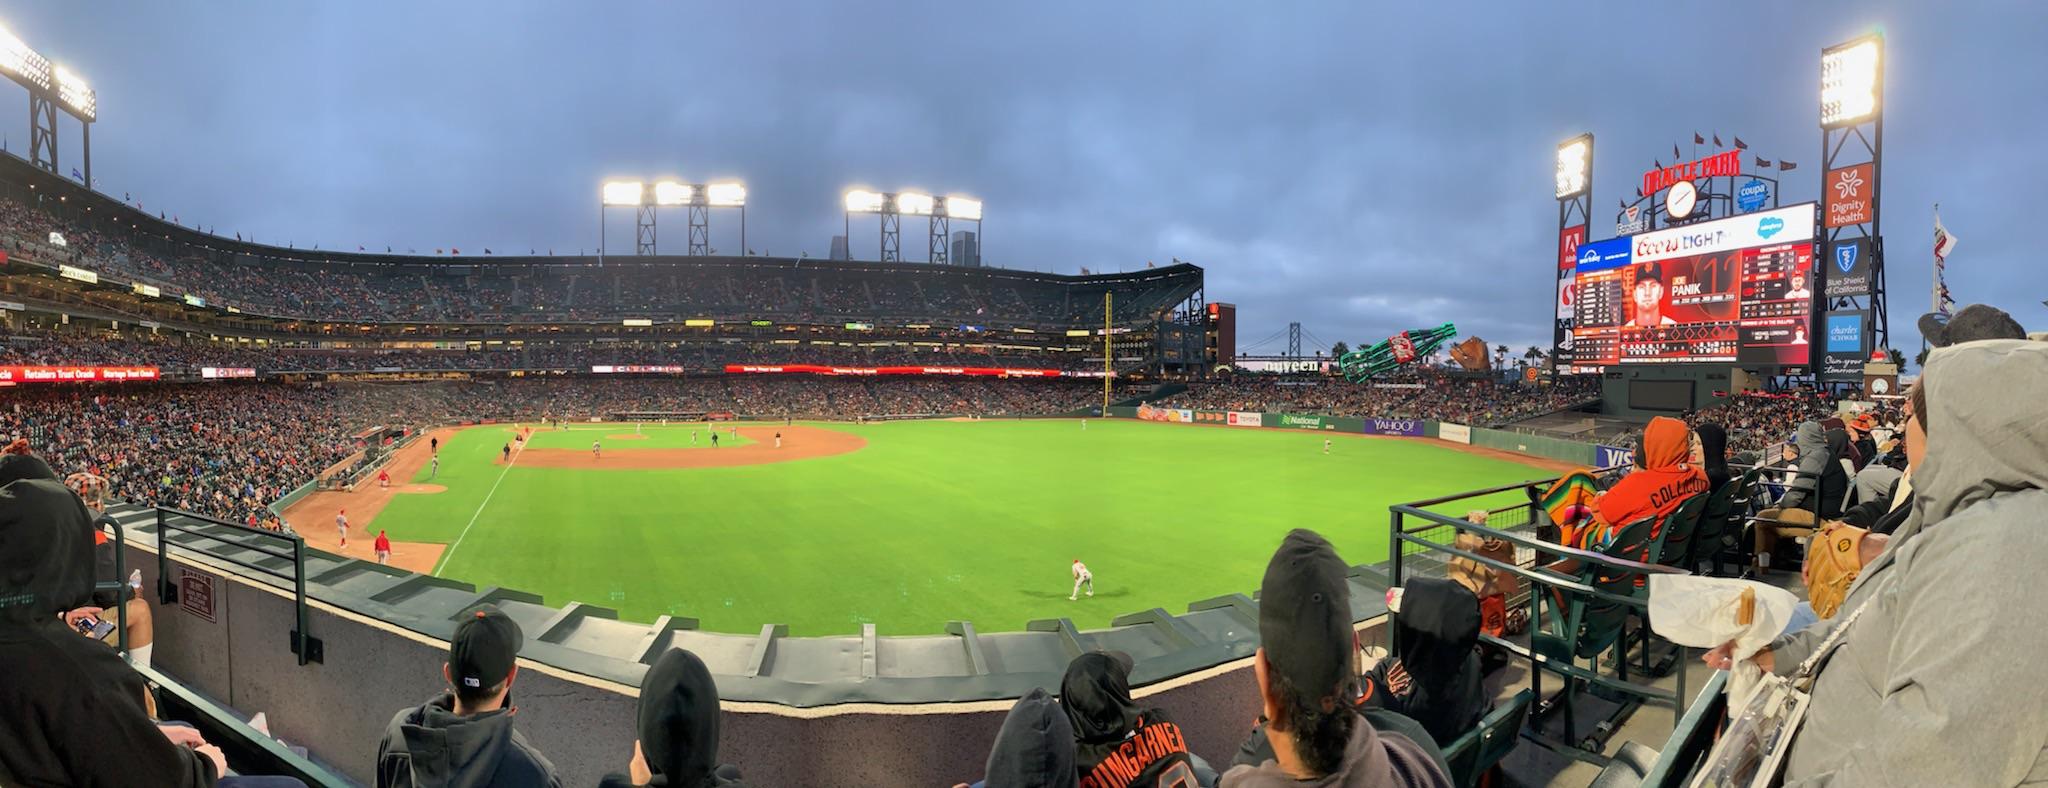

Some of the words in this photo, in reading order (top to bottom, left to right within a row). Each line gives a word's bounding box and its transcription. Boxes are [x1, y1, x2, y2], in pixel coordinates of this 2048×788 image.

[1642, 160, 1698, 196] ORACLE
[1701, 149, 1741, 177] PARK
[1740, 183, 1766, 197] coupa
[1831, 200, 1865, 214] Dignity
[1832, 211, 1864, 225] Health
[1637, 236, 1679, 257] Coors
[1683, 230, 1724, 250] LIGHT
[1827, 279, 1842, 287] Blue
[1843, 276, 1865, 286] Shield
[1672, 283, 1701, 296] PANIK
[1824, 286, 1832, 295] of
[1832, 284, 1868, 295] California
[1265, 361, 1319, 372] nuveen
[1824, 355, 1841, 365] Own
[1844, 359, 1862, 369] your
[24, 369, 56, 379] Retailers
[57, 369, 75, 379] Trust
[75, 369, 96, 379] Oracle
[1290, 415, 1321, 425] National
[1374, 419, 1415, 432] YAHOO!
[1605, 449, 1633, 468] VIS
